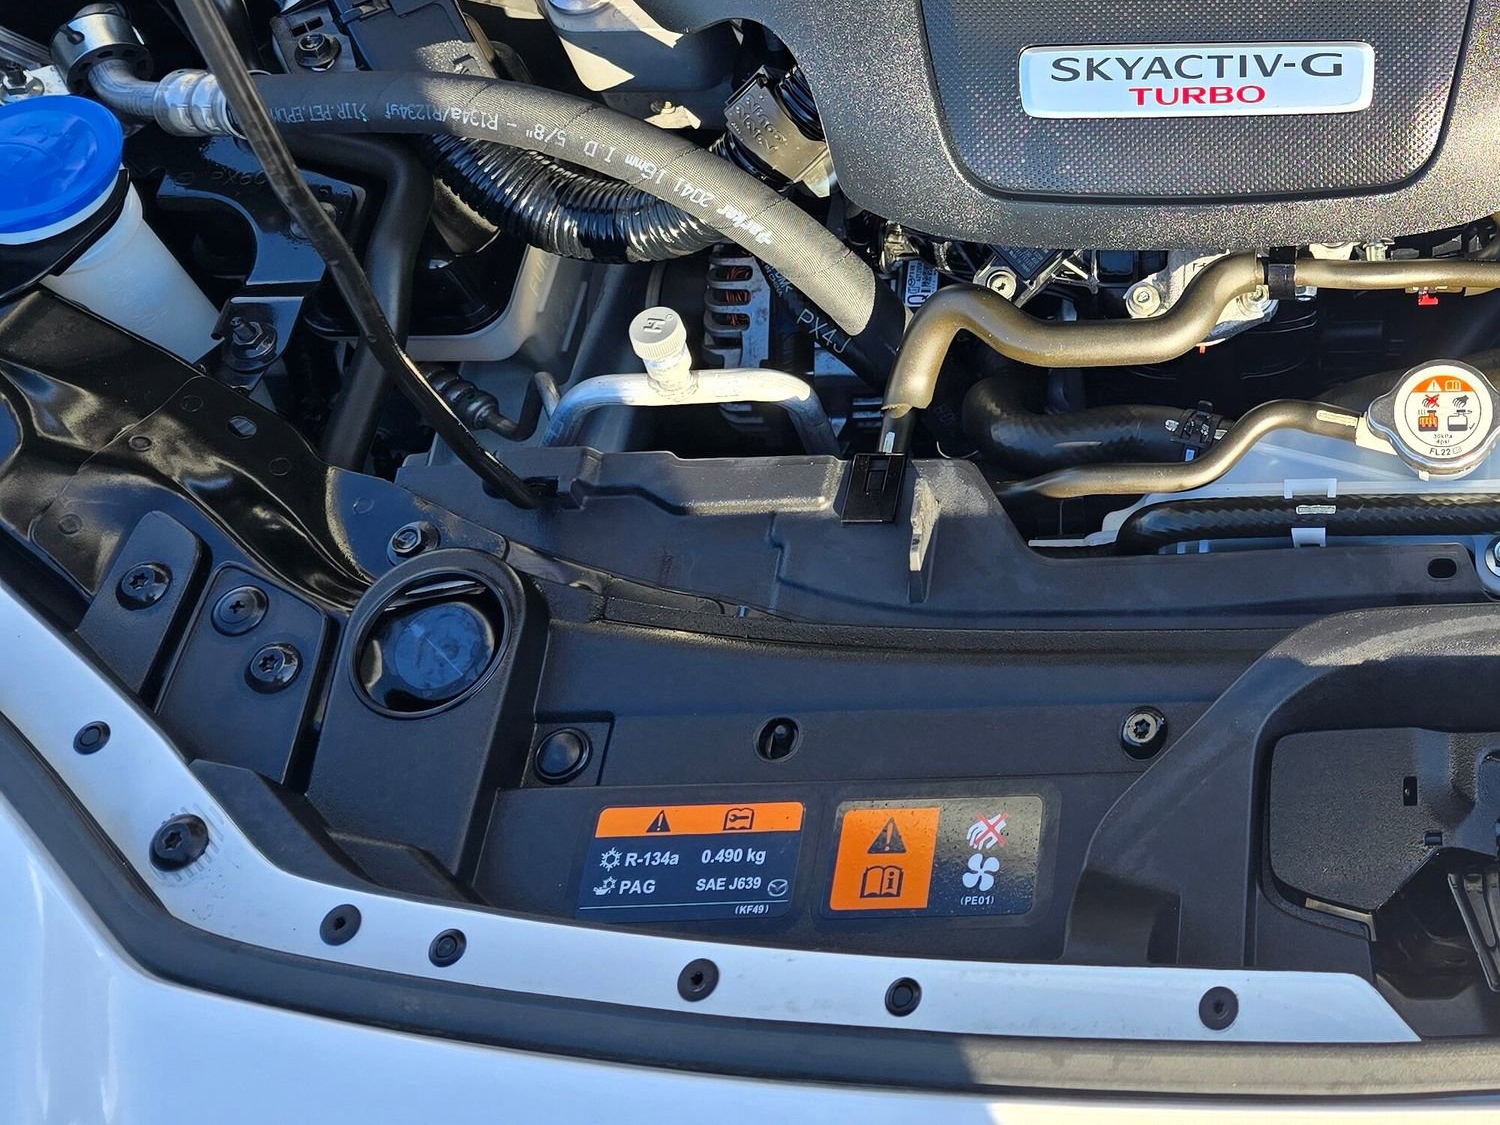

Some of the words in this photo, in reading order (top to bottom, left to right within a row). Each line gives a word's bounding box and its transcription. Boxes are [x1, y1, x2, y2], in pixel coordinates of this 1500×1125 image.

[1051, 53, 1344, 82] SKYACTIV-G
[1129, 85, 1266, 106] TURBO
[384, 102, 500, 131] R134a/R1234yf
[797, 308, 852, 354] PX4J
[1429, 448, 1451, 456] FL22
[625, 849, 680, 867] R-134a
[701, 848, 741, 865] 0.490
[745, 848, 767, 868] kg
[619, 879, 656, 895] PAG
[695, 877, 726, 893] SAE
[728, 876, 762, 891] J639
[735, 903, 769, 916] (KF49)
[960, 894, 995, 907] (PE01)
